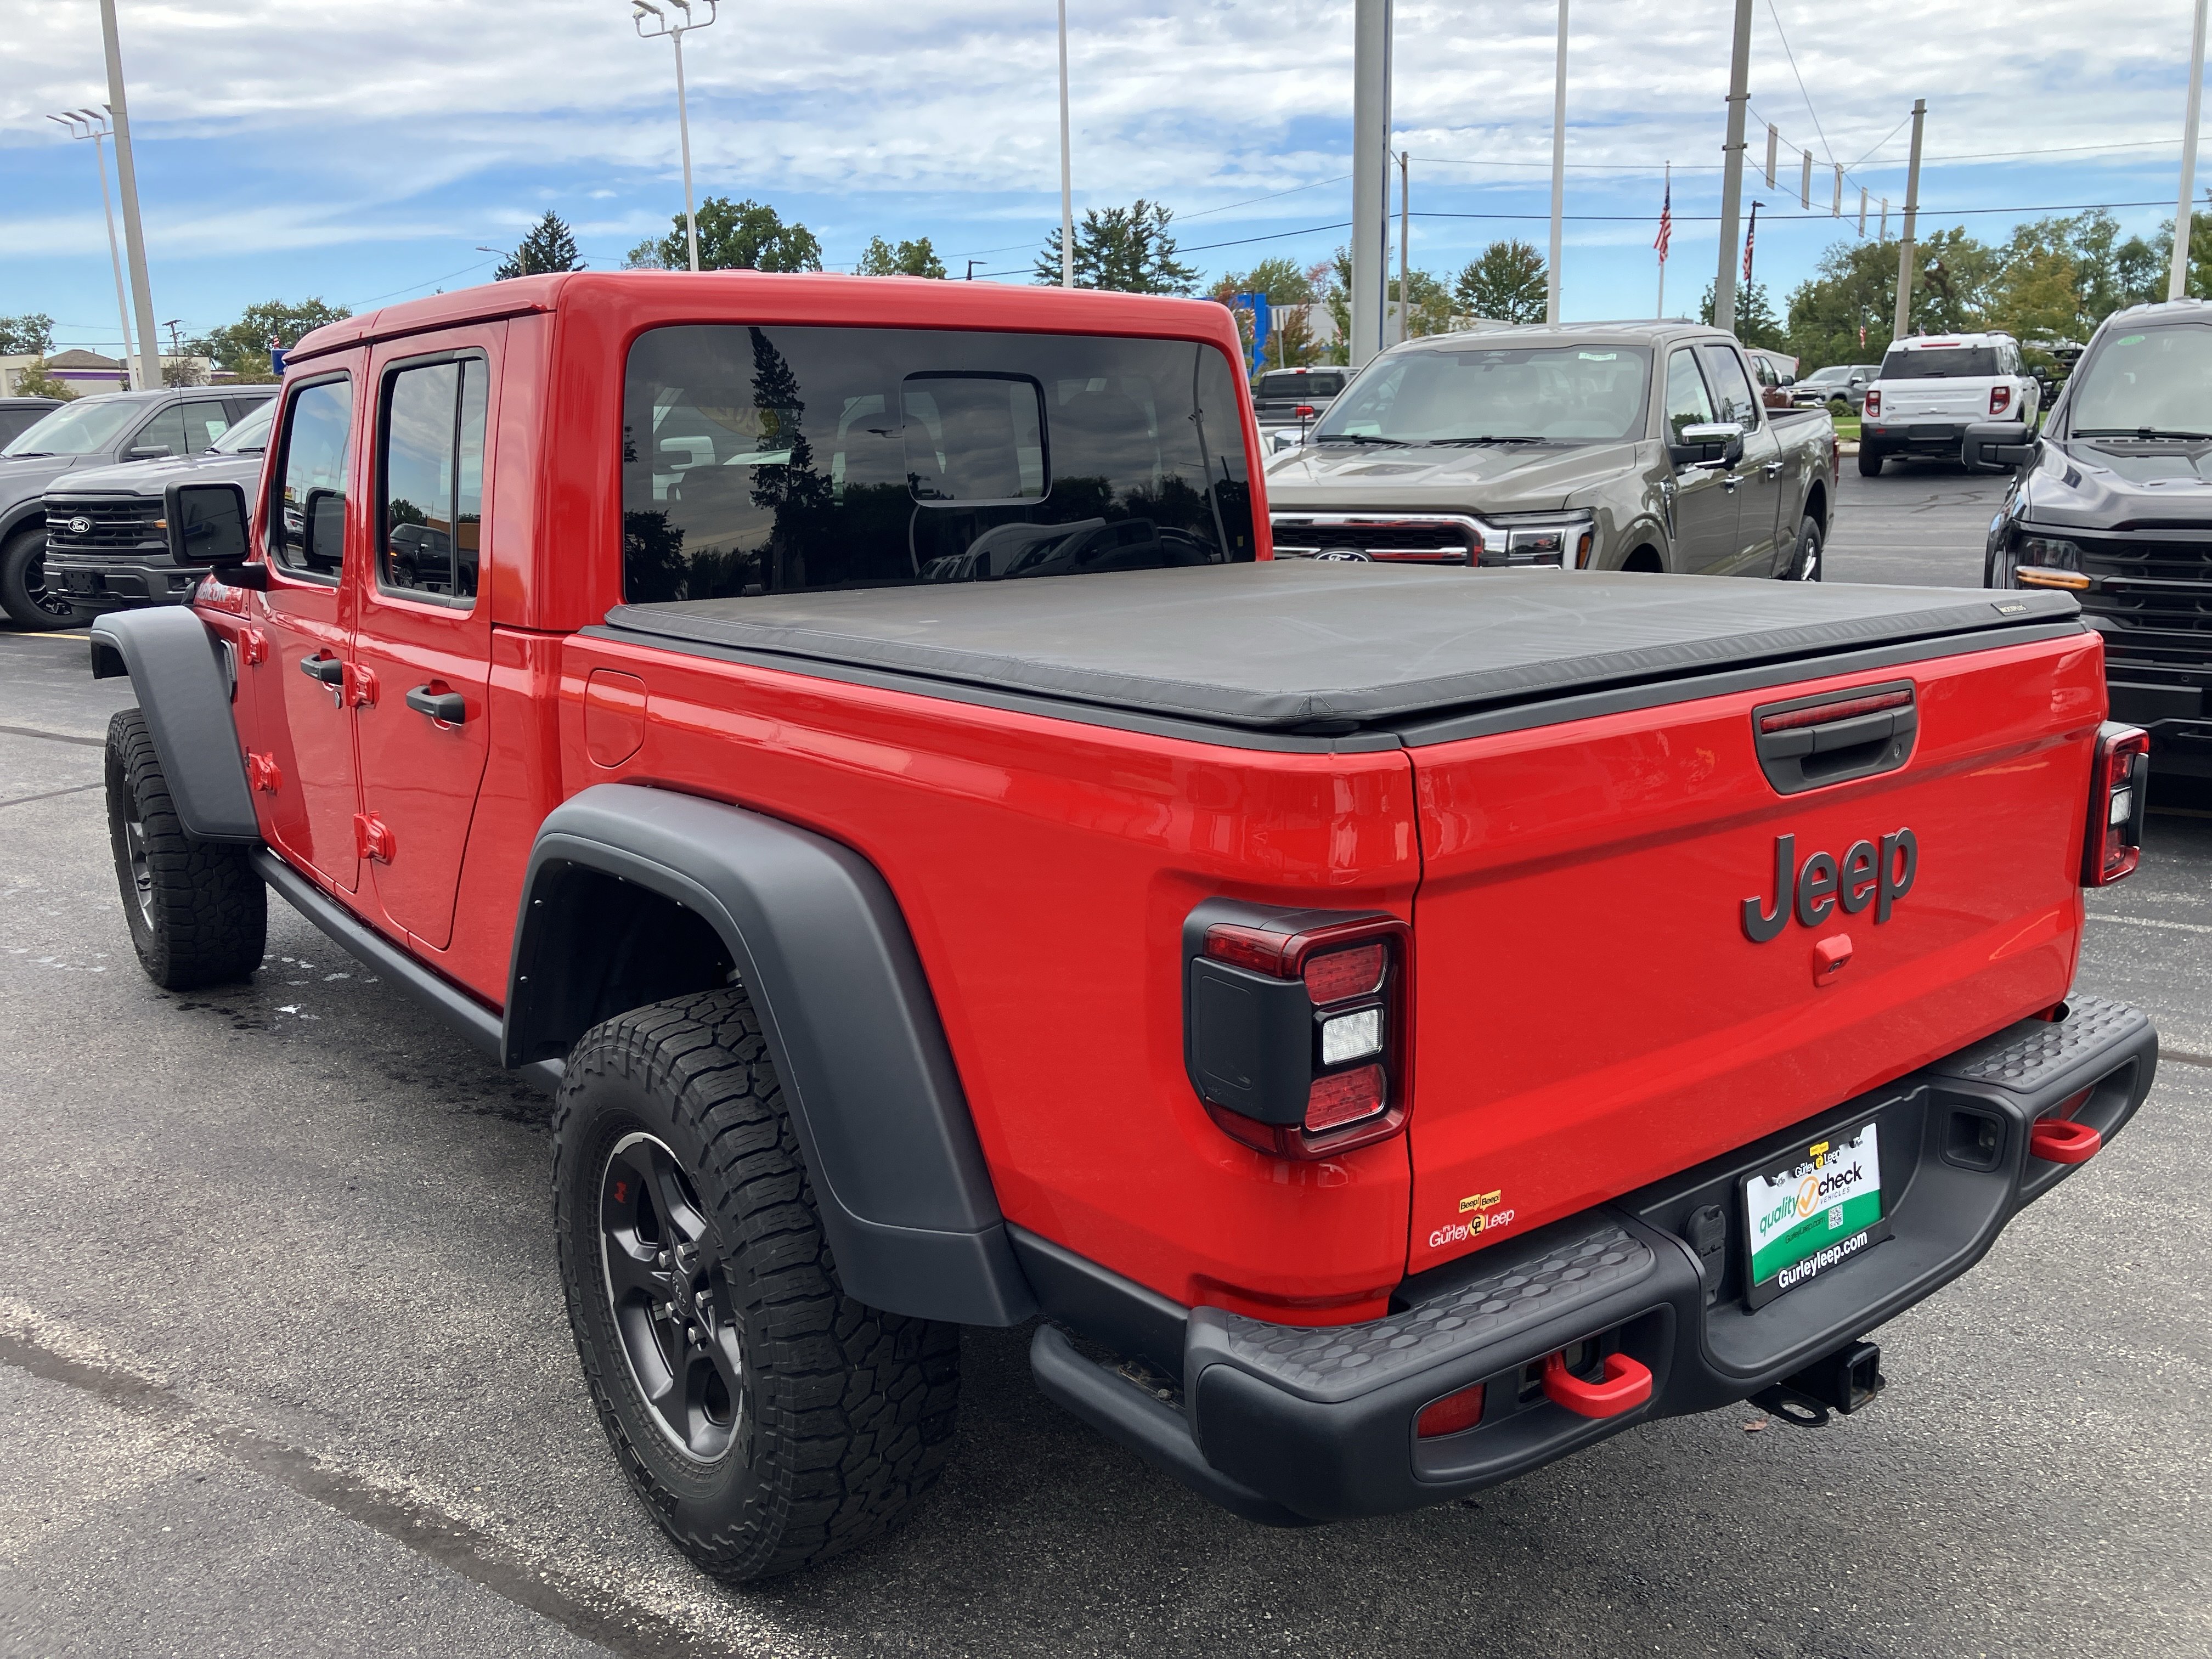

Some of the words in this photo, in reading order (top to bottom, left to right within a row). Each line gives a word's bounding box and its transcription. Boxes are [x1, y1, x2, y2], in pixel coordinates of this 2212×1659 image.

[72, 520, 85, 530] Ford
[1999, 605, 2027, 613] MOSTPLUS
[1742, 827, 1918, 943] Jeep
[1795, 1161, 1814, 1177] Gurley
[1824, 1149, 1841, 1165] Leep
[1460, 1197, 1480, 1210] Beep!
[1482, 1193, 1500, 1206] Beep!
[1760, 1193, 1800, 1237] quality
[1819, 1161, 1863, 1196] check
[1820, 1186, 1850, 1205] VEHICLES
[1429, 1223, 1470, 1248] Gurley
[1485, 1210, 1515, 1229] Leep
[1779, 1232, 1868, 1288] Gurleyleep.com
